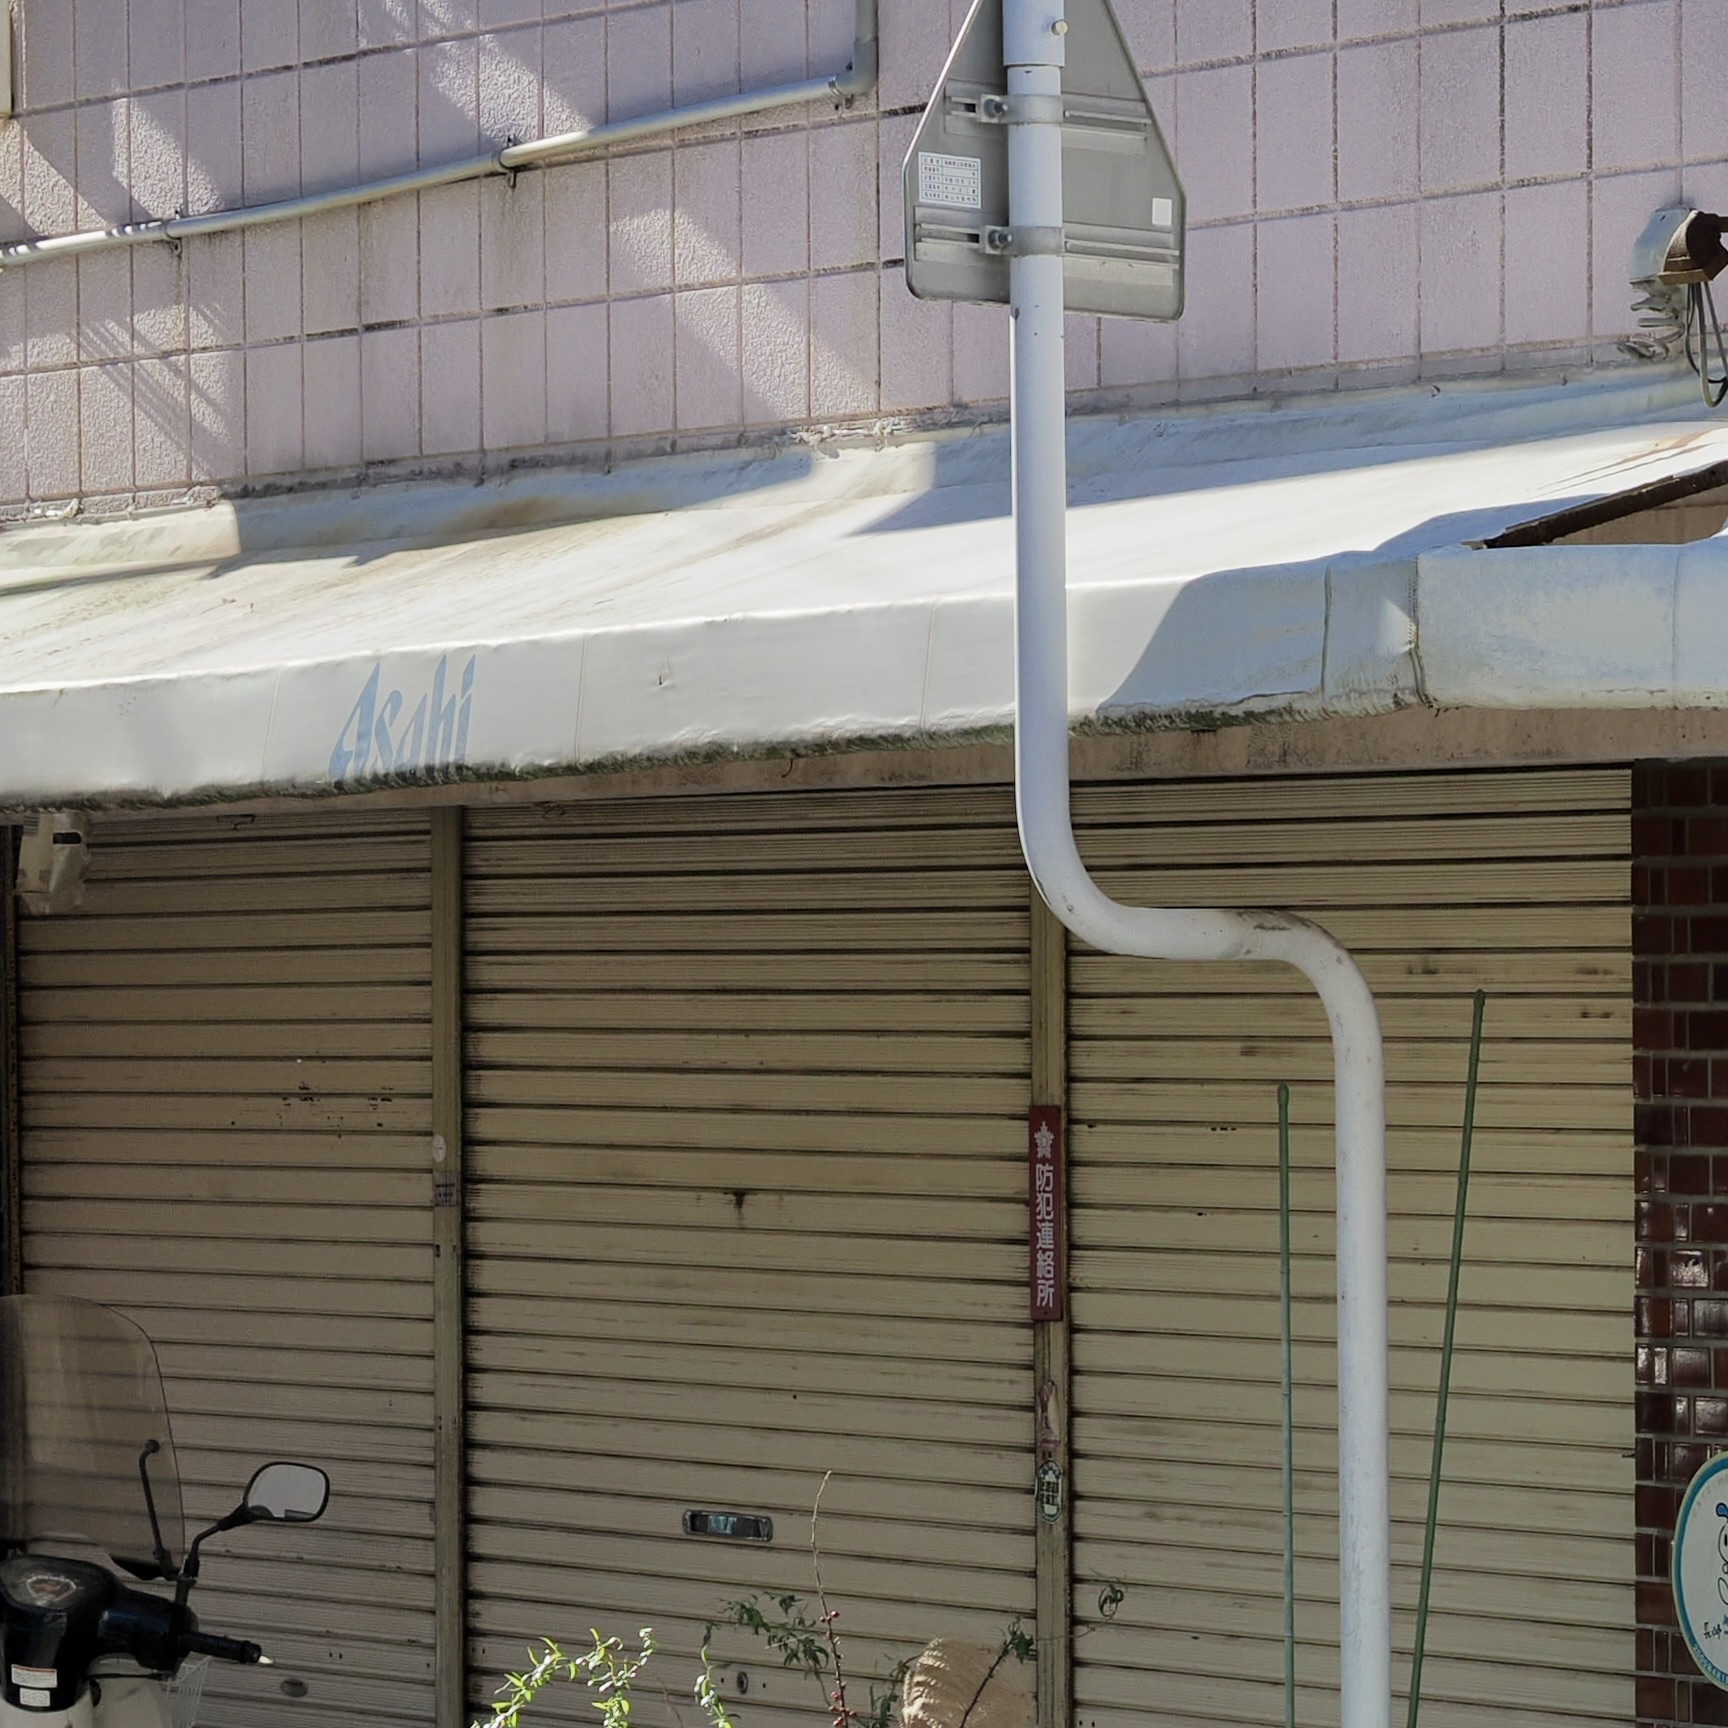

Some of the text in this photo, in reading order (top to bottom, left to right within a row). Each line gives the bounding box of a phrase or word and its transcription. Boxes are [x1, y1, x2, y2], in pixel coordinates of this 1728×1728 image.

[329, 654, 476, 783] Asahi
[1036, 1164, 1054, 1308] 防犯連絡所
